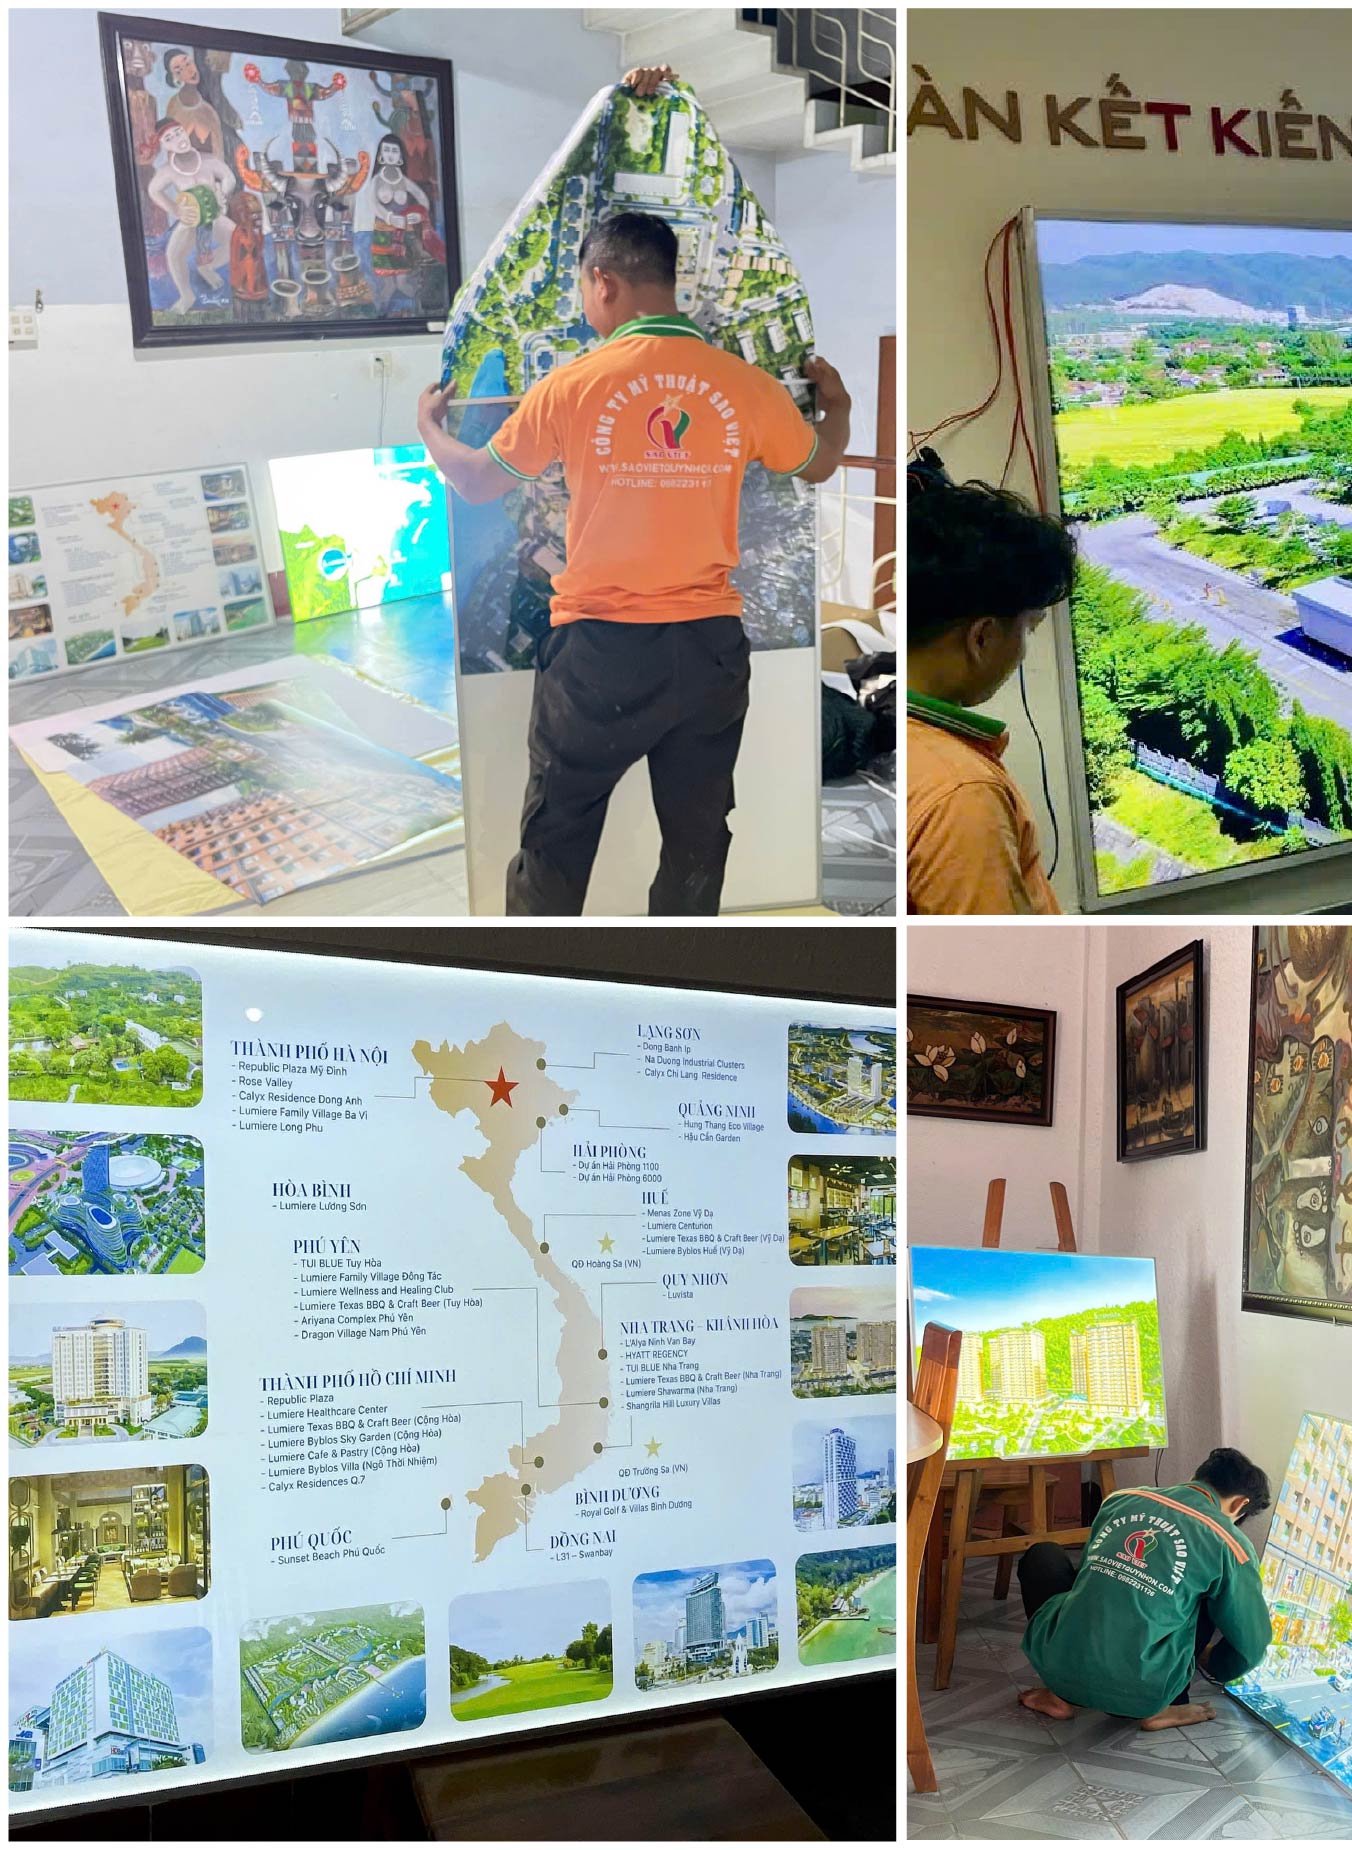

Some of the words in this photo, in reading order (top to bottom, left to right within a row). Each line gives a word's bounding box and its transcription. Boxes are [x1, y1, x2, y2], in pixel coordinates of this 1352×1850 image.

[907, 64, 1021, 143] ÀN
[1046, 73, 1190, 150] KẾT
[607, 391, 629, 411] TY
[709, 391, 735, 419] SAO
[638, 1024, 672, 1040] LẠNG
[675, 1027, 701, 1040] SƠN
[230, 1038, 292, 1059] THÀNH
[296, 1042, 329, 1061] PHỐ
[334, 1046, 356, 1062] HÀ
[360, 1046, 388, 1067] NỘI
[643, 1043, 662, 1053] Dong
[239, 1062, 280, 1074] Republic
[282, 1063, 307, 1074] Plaza
[310, 1064, 324, 1077] Mỹ
[239, 1076, 263, 1087] Rose
[266, 1077, 293, 1090] Valley
[239, 1091, 265, 1102] Calyx
[268, 1092, 316, 1104] Residence
[318, 1094, 343, 1106] Dong
[345, 1096, 362, 1106] Anh
[678, 1100, 722, 1118] QUẢNG
[726, 1105, 755, 1118] NINH
[239, 1121, 278, 1131] Lumiere
[280, 1122, 303, 1134] Long
[306, 1123, 323, 1132] Phu
[573, 1141, 597, 1157] HẢI
[601, 1143, 646, 1158] PHÒNG
[617, 1162, 641, 1172] Phòng
[643, 1162, 659, 1171] 1100
[273, 1179, 307, 1198] HÒA
[312, 1180, 351, 1198] BÌNH
[642, 1188, 669, 1204] HUẾ
[280, 1201, 316, 1212] Lumiere
[647, 1222, 676, 1230] Lumiere
[679, 1222, 712, 1230] Centurion
[294, 1236, 326, 1254] PHÚ
[329, 1236, 361, 1253] YÊN
[301, 1259, 316, 1268] TUI
[319, 1259, 343, 1268] BLUE
[346, 1259, 362, 1269] Tuy
[364, 1257, 382, 1268] Hòa
[587, 1259, 610, 1269] Hoàng
[613, 1260, 622, 1268] Sa
[625, 1259, 641, 1268] (VN)
[662, 1273, 687, 1289] QUY
[692, 1273, 728, 1286] NHƠN
[301, 1287, 337, 1296] Lumiere
[340, 1286, 379, 1296] Wellness
[381, 1286, 397, 1295] and
[400, 1285, 432, 1296] Healing
[434, 1285, 454, 1294] Club
[668, 1290, 693, 1299] Luvista
[301, 1315, 335, 1327] Ariyana
[338, 1315, 376, 1325] Complex
[378, 1313, 395, 1323] Phú
[398, 1313, 414, 1322] Yên
[621, 1320, 648, 1335] NHA
[651, 1319, 694, 1334] TRANG
[706, 1315, 749, 1331] KHÁNH
[752, 1315, 778, 1329] HÒA
[301, 1330, 334, 1341] Dragon
[337, 1329, 367, 1339] Village
[369, 1328, 390, 1337] Nam
[392, 1327, 408, 1337] Phú
[411, 1326, 426, 1336] Yên
[626, 1351, 650, 1360] HYATT
[653, 1350, 688, 1358] REGENCY
[259, 1373, 317, 1391] THÀNH
[323, 1369, 355, 1388] PHỐ
[359, 1369, 381, 1387] HỒ
[385, 1368, 412, 1385] CHÍ
[415, 1369, 456, 1384] MINH
[268, 1409, 304, 1420] Lumiere
[307, 1406, 355, 1418] Healthcare
[358, 1405, 388, 1415] Center
[268, 1452, 305, 1463] Lumiere
[307, 1450, 329, 1461] Cafe
[331, 1449, 338, 1458] &
[340, 1448, 369, 1459] Pastry
[400, 1443, 420, 1454] Hòa)
[269, 1481, 294, 1492] Calyx
[297, 1477, 349, 1489] Residences
[351, 1476, 366, 1486] Q.7
[575, 1488, 608, 1505] BÌNH
[612, 1485, 660, 1501] DƯƠNG
[271, 1532, 304, 1551] PHÚ
[308, 1527, 352, 1549] QUỐC
[1113, 1517, 1126, 1527] TY
[1174, 1538, 1188, 1557] SAO
[278, 1554, 310, 1565] Sunset
[313, 1551, 340, 1562] Beach
[343, 1549, 360, 1559] Phú
[362, 1546, 386, 1557] Quốc
[556, 1552, 570, 1561] L31
[579, 1548, 613, 1559] Swanbay
